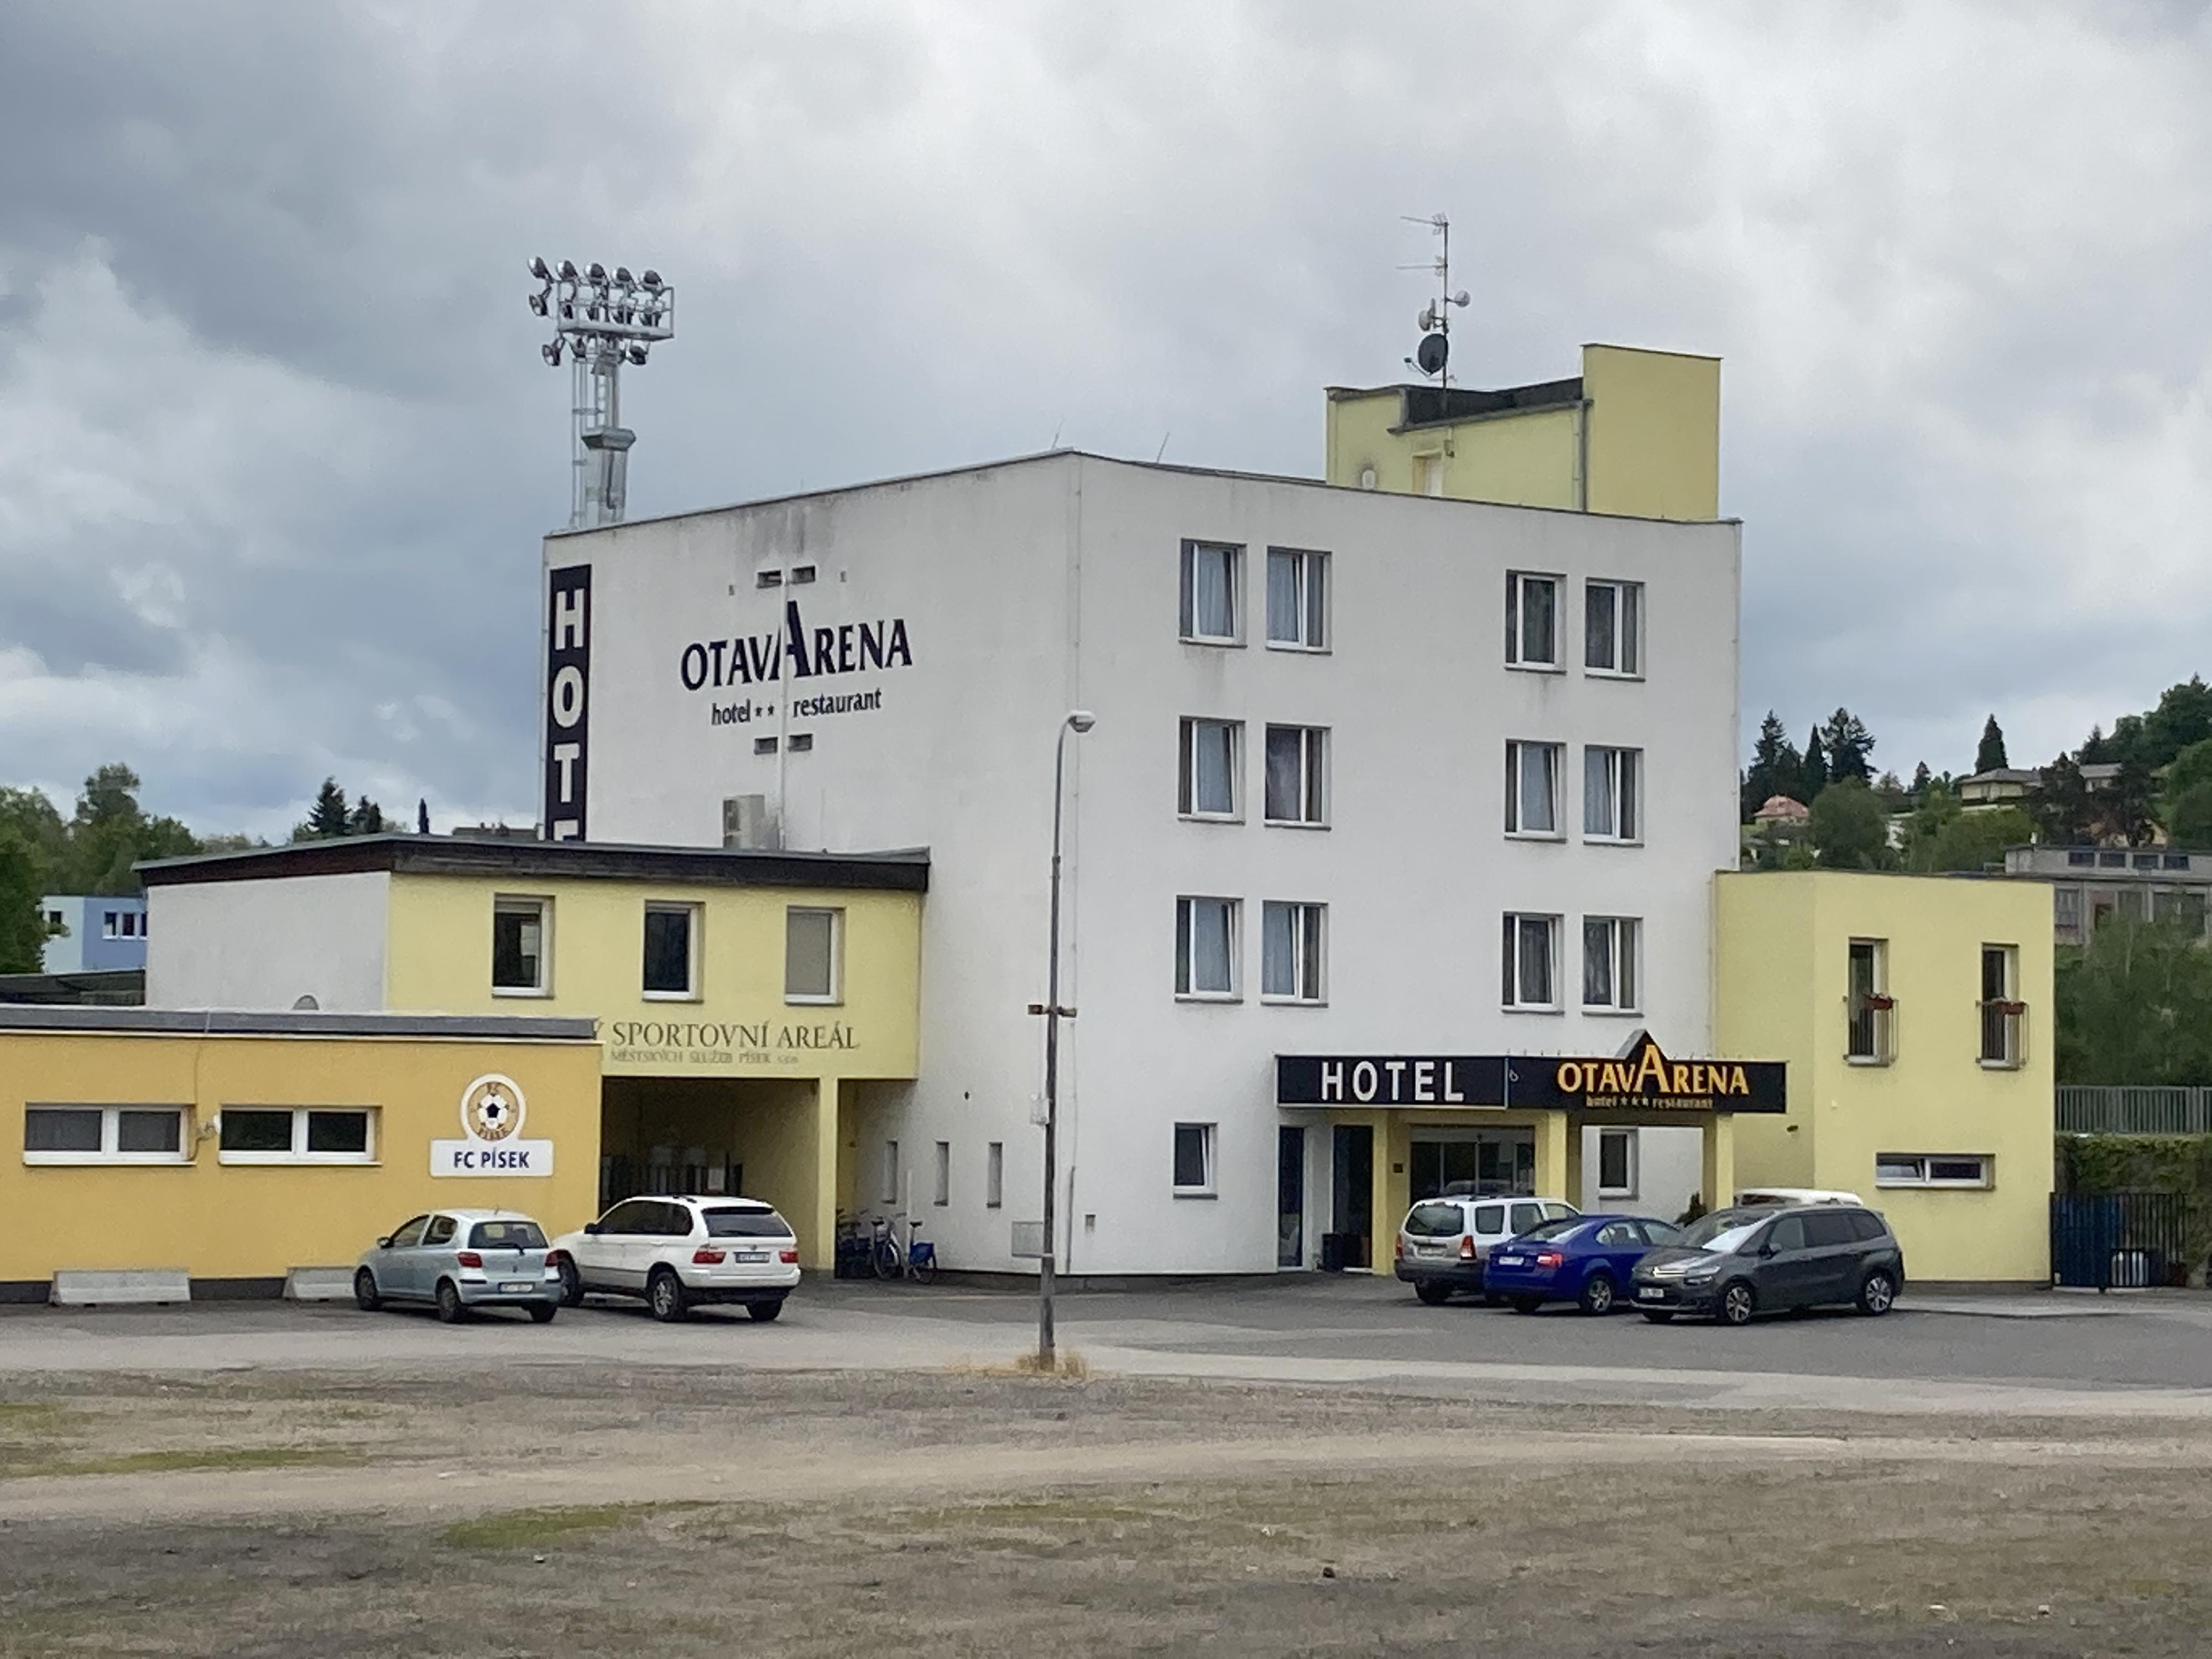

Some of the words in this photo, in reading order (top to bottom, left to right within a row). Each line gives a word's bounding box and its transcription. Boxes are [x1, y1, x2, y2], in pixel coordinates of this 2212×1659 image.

[711, 698, 750, 725] hotel
[793, 688, 881, 718] restaurant
[612, 1020, 770, 1048] SPORTOVNÍ
[777, 1020, 860, 1049] AREÁL
[1321, 1061, 1464, 1102] HOTEL
[1586, 1096, 1617, 1107] hotel
[1652, 1097, 1713, 1109] restaurant
[453, 1151, 474, 1168] FC
[481, 1147, 530, 1168] PÍSEK
